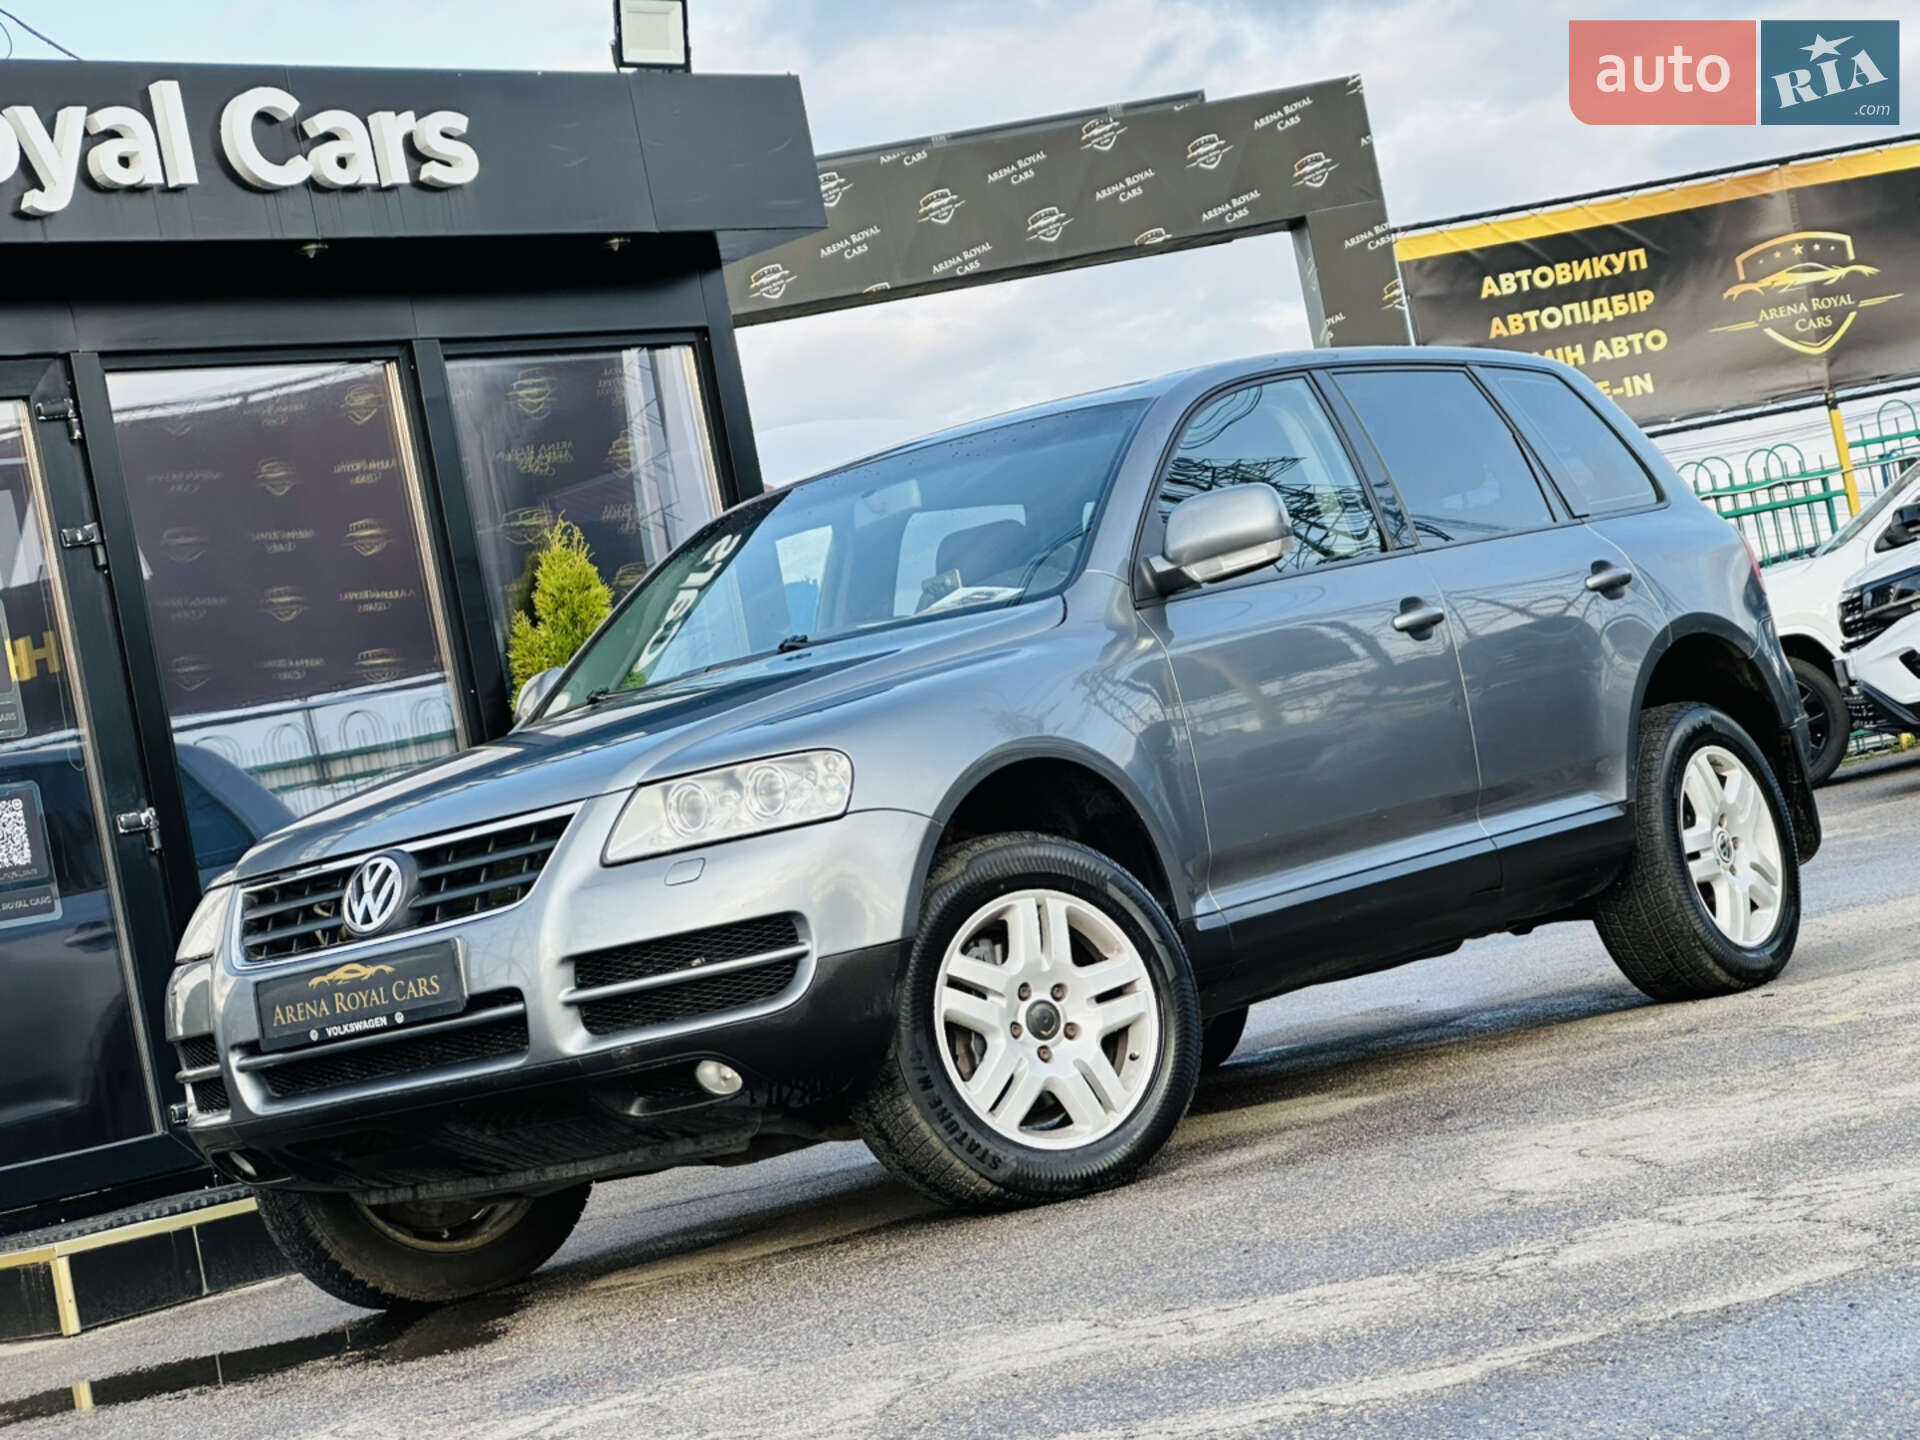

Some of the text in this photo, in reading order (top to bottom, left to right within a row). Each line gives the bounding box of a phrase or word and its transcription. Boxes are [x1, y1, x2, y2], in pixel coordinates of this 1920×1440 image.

[1276, 114, 1302, 132] CARS
[219, 86, 480, 190] Cars
[1010, 168, 1036, 185] CARS
[1118, 186, 1144, 203] CARS
[1224, 206, 1250, 223] CARS
[843, 242, 869, 260] CARS
[955, 259, 981, 276] CARS
[1480, 247, 1649, 299] АВТОВИКУП
[1488, 288, 1656, 339] АВТОПІДБІР
[1758, 293, 1857, 322] ARENA ROYAL
[1794, 314, 1834, 332] CARS
[1592, 328, 1669, 363] АВТО
[272, 974, 441, 1027] ARENA ROYAL CARS
[325, 1015, 388, 1038] VOLKSWAGEN
